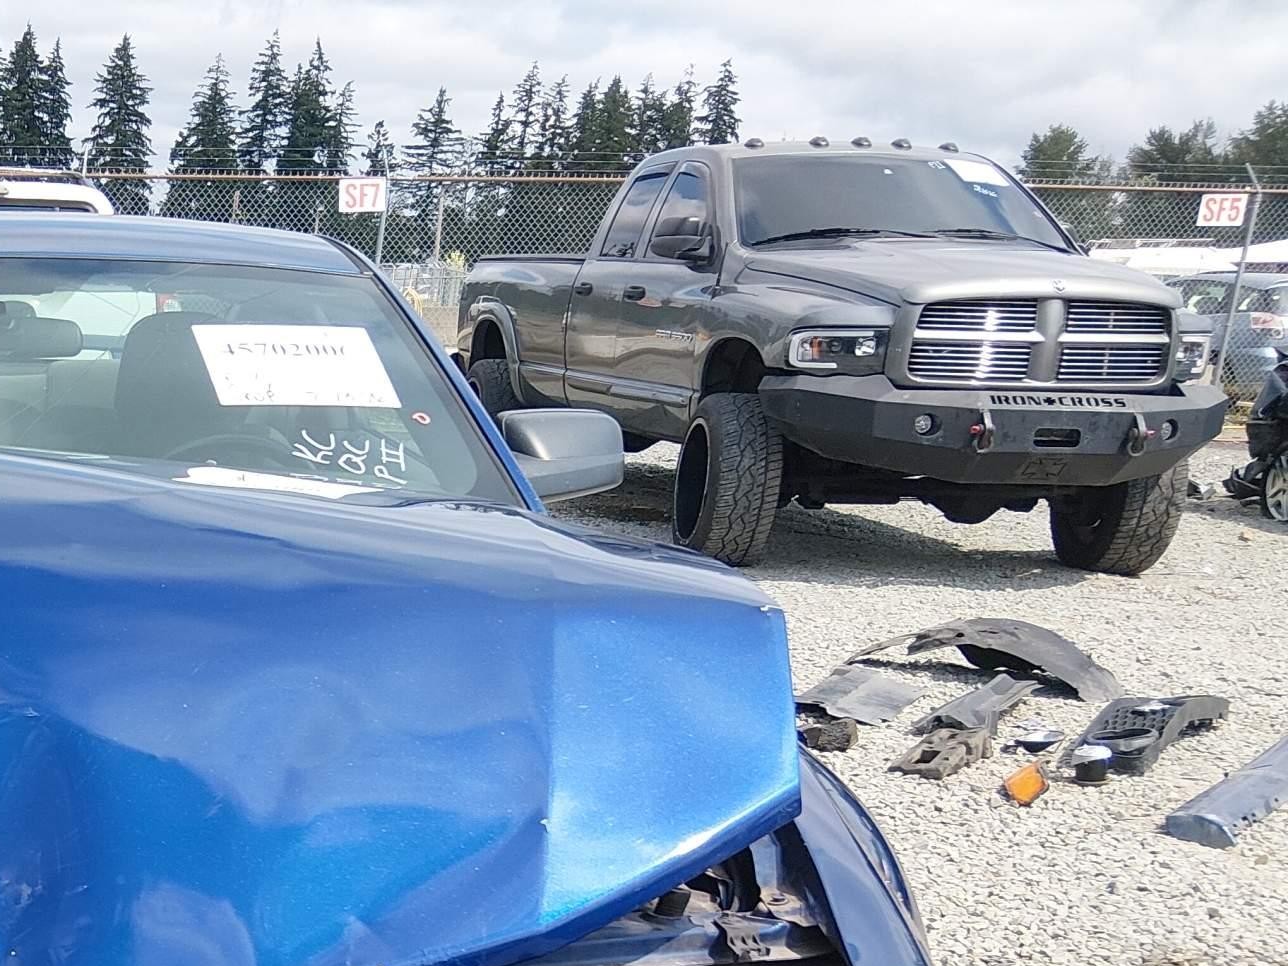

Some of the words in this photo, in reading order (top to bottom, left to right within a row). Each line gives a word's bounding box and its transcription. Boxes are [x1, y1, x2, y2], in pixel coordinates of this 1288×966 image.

[345, 183, 380, 208] SF7
[1202, 197, 1241, 221] SF5
[989, 395, 1041, 405] IRON
[1057, 396, 1127, 407] CROSS
[291, 429, 336, 465] KC
[337, 439, 370, 475] QC
